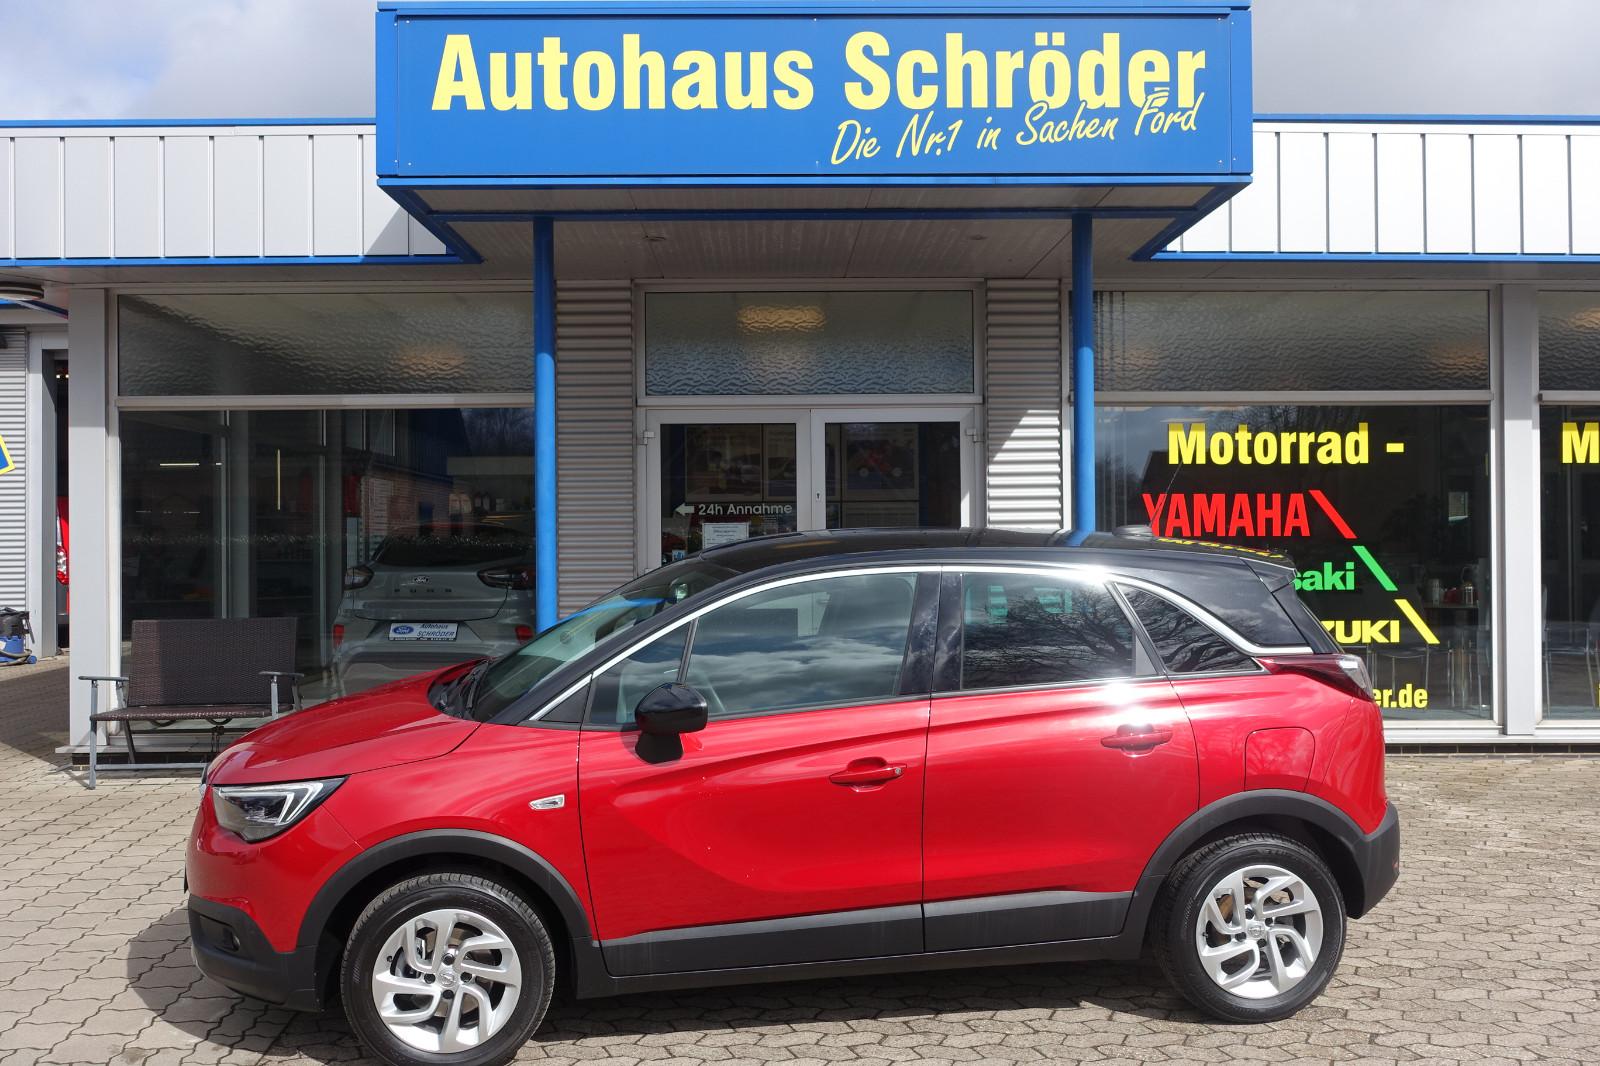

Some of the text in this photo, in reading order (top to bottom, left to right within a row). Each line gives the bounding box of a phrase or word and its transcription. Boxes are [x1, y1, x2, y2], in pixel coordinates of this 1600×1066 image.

[432, 31, 1206, 111] Autohaus Schröder
[831, 88, 1205, 165] Die Nr.1 in Sachen Ford
[1168, 422, 1369, 465] Motorrad
[698, 504, 792, 515] 24h Annahme
[1142, 493, 1311, 538] YAMAHA
